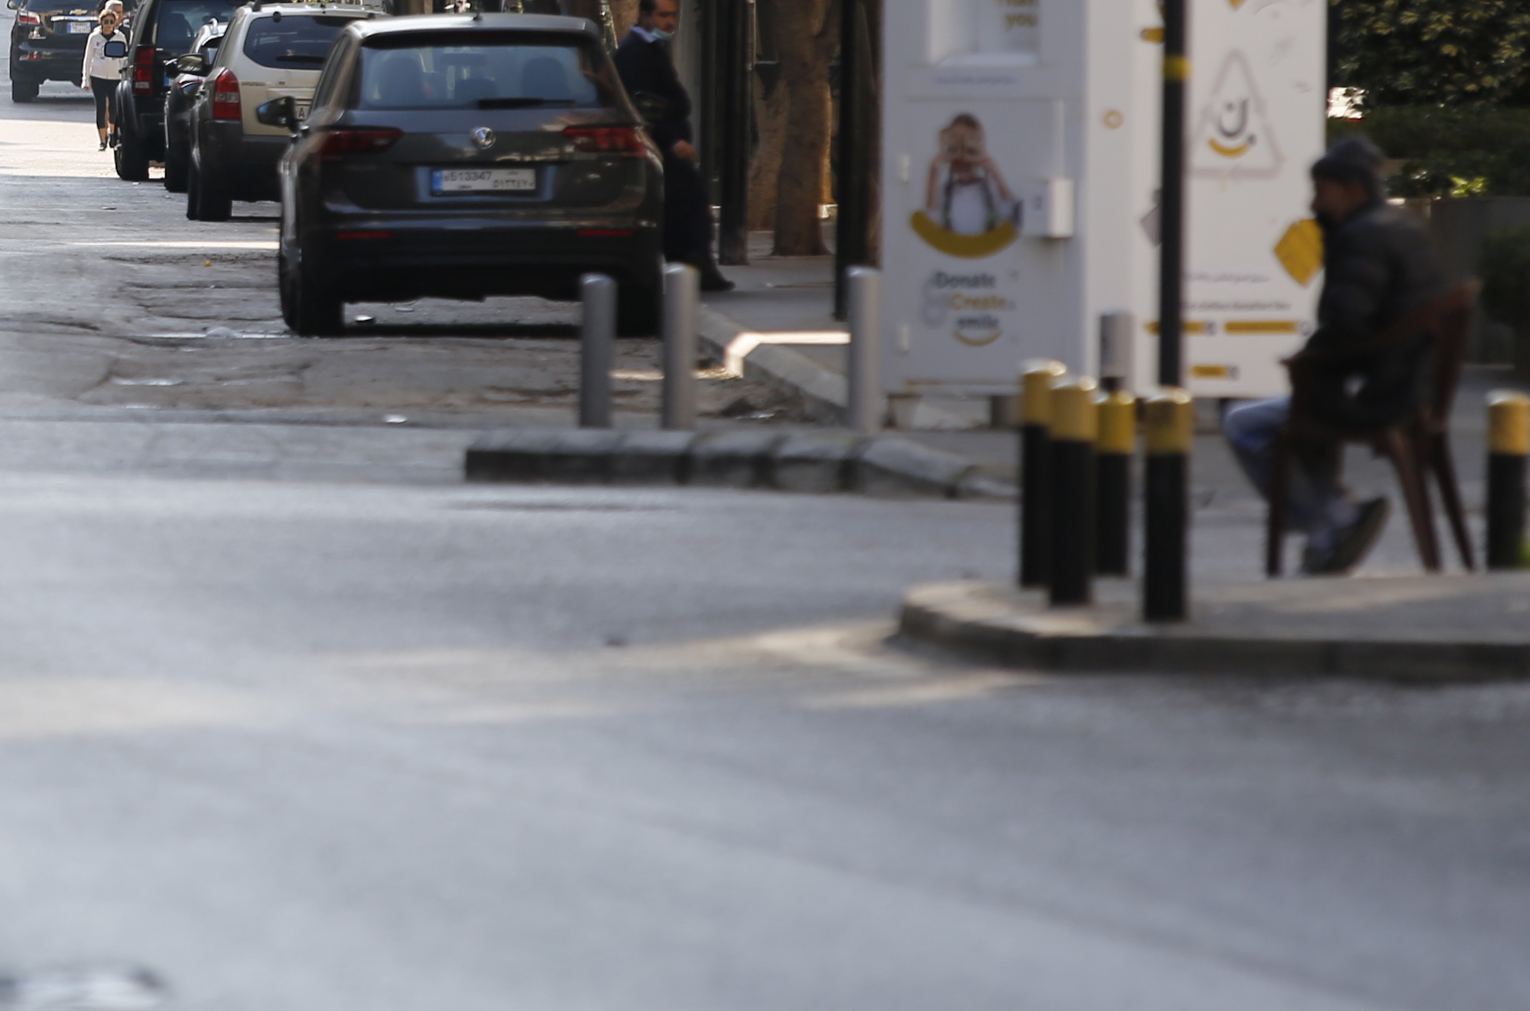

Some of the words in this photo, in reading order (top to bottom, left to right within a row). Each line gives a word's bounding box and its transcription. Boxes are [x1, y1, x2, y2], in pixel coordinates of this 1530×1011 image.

[1003, 13, 1039, 31] you
[935, 270, 996, 289] Donate
[950, 292, 1007, 311] Create
[957, 315, 1000, 329] smile
